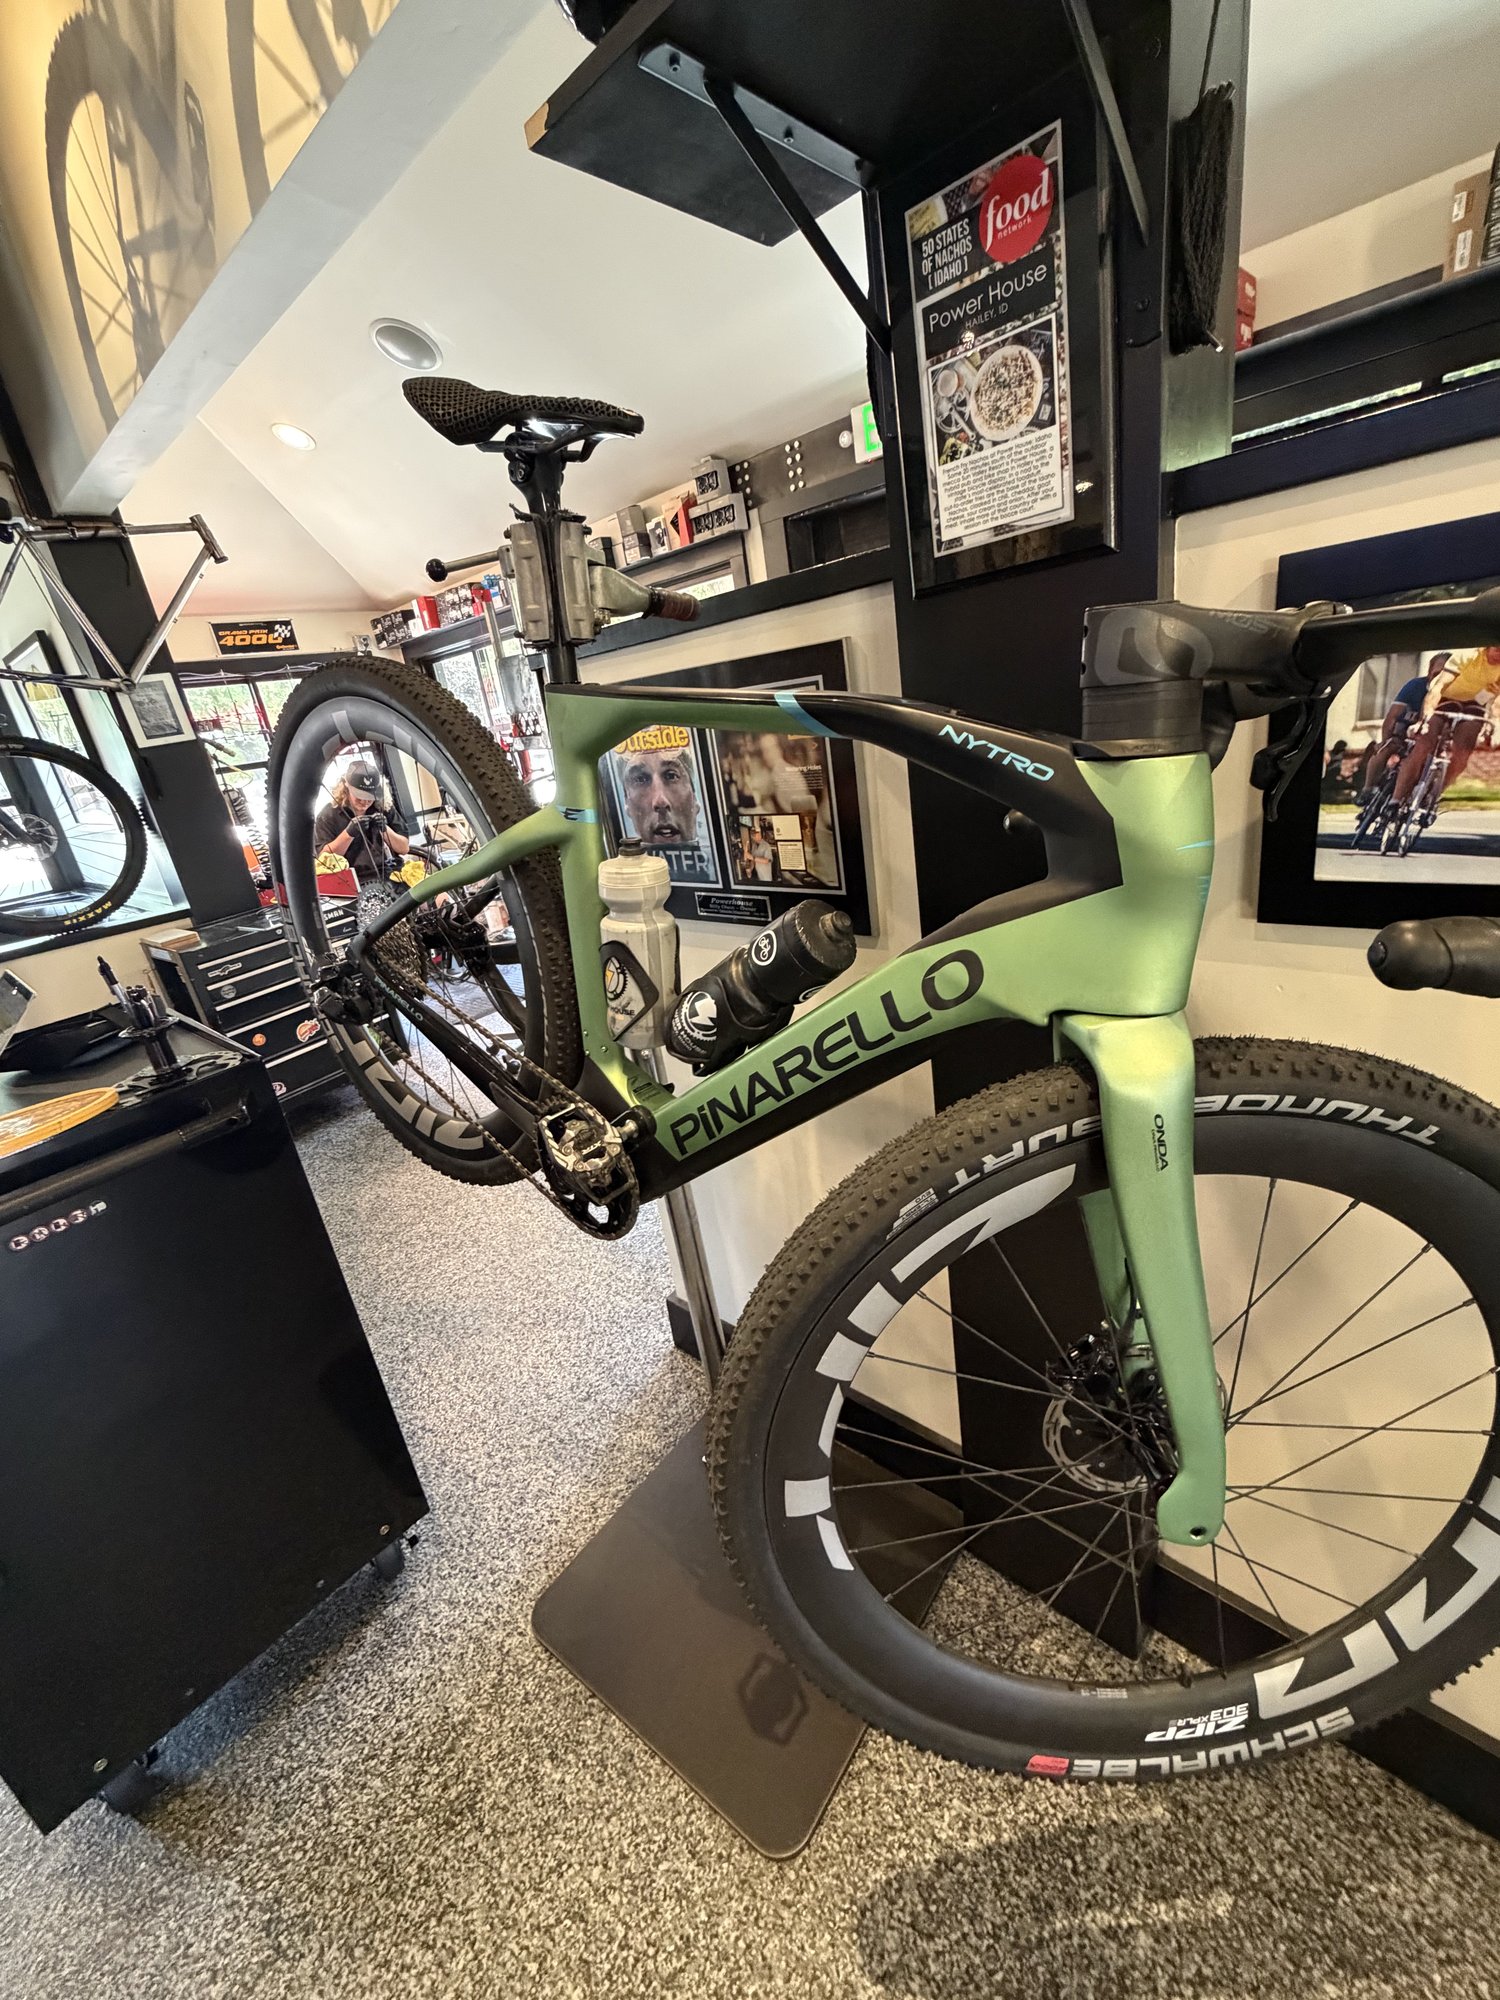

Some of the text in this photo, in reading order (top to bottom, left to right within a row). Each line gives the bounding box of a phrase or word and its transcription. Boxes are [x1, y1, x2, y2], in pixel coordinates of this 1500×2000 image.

[985, 168, 1050, 252] food
[922, 218, 970, 257] 50 STATES
[998, 216, 1032, 240] network
[922, 236, 973, 276] OF NACHOS
[934, 263, 962, 288] IDAHO
[929, 264, 1047, 333] Power House
[965, 302, 1009, 330] HAILEY, ID
[938, 724, 1054, 781] NYTRO
[650, 850, 708, 873] ATER
[323, 909, 345, 921] SMAN
[710, 897, 753, 907] Powerhouse
[669, 949, 984, 1156] PINARELLO
[1194, 1095, 1439, 1146] THUNDE
[1154, 1114, 1169, 1171] ONDA
[914, 1190, 932, 1204] EVO
[1144, 1714, 1249, 1743] ZIPP
[1177, 1703, 1249, 1727] 303 XPLR
[1070, 1706, 1355, 1777] SCHWALBE
